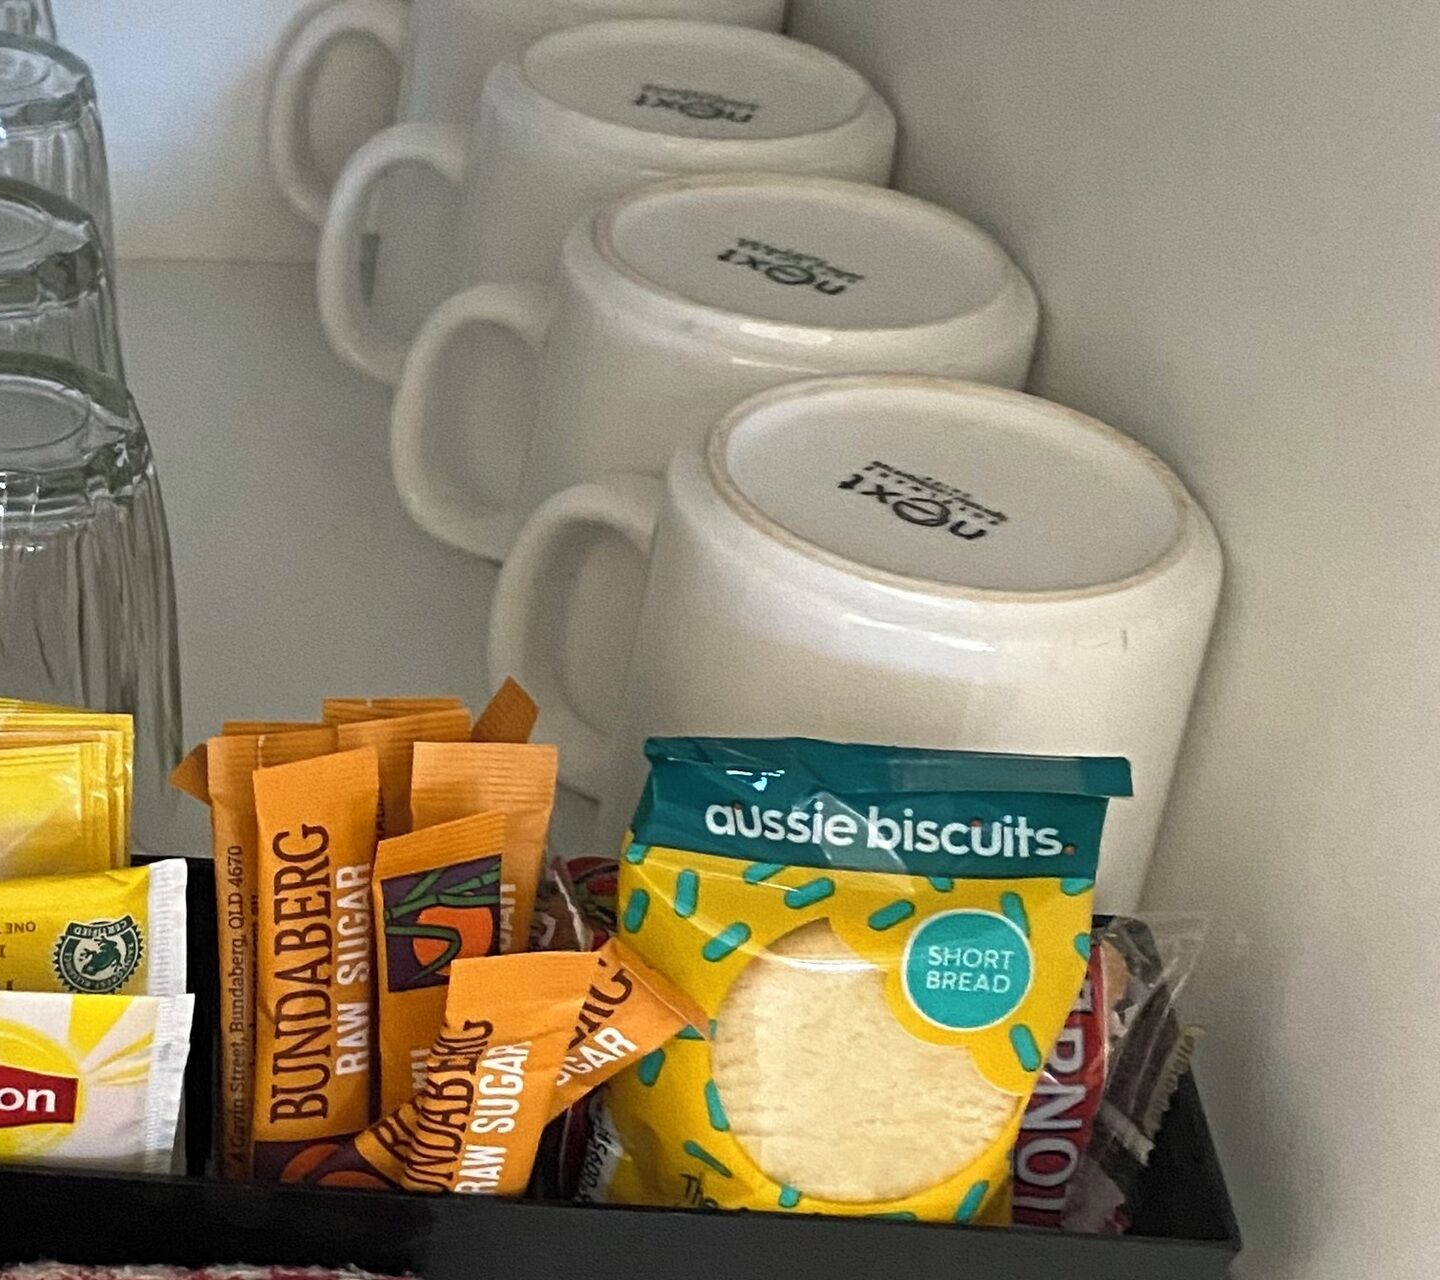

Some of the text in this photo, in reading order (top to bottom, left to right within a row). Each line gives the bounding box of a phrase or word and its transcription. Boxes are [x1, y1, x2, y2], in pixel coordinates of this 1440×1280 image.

[717, 248, 847, 295] next
[837, 473, 988, 540] next
[705, 799, 857, 847] aussie
[227, 845, 242, 886] 4670
[6, 921, 36, 934] ONE
[227, 892, 245, 931] QLD
[228, 935, 247, 1034] Bundaberg,
[269, 823, 332, 1124] BUNDABERG
[335, 863, 371, 1076] RAW SUGAR
[925, 971, 1012, 995] BREAD
[927, 946, 1014, 971] SHORT
[230, 1037, 246, 1093] Street,
[555, 1026, 639, 1087] GAR
[454, 1040, 533, 1193] RAW SUGAR
